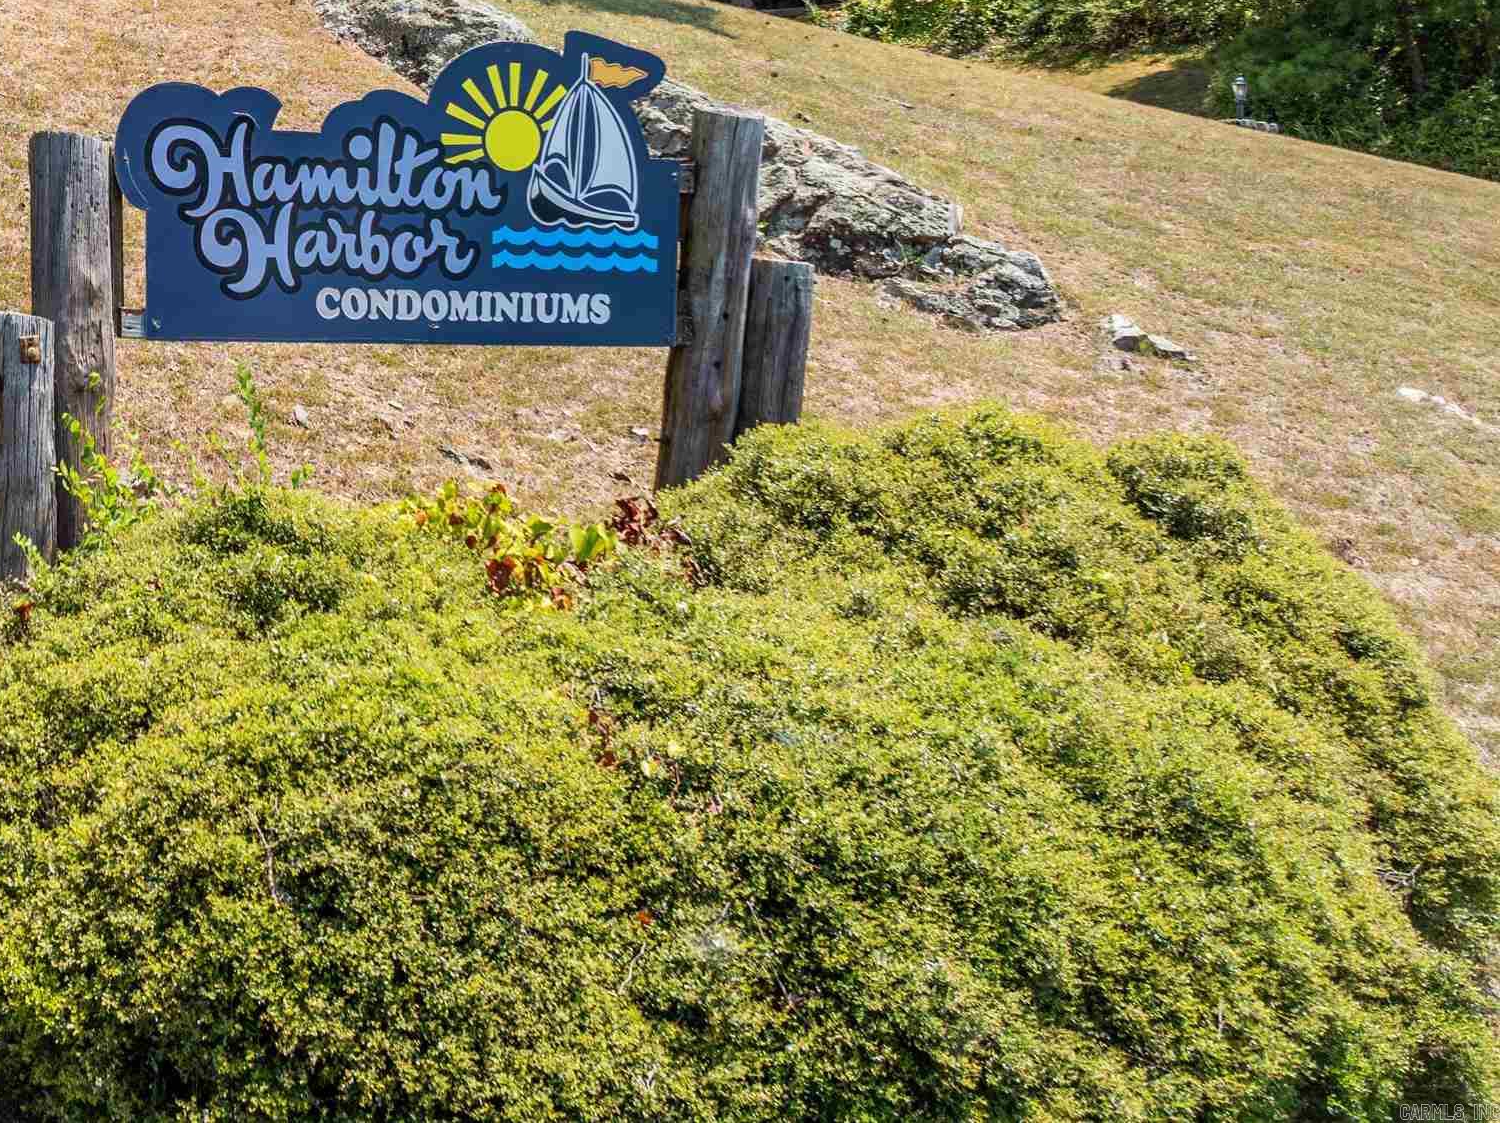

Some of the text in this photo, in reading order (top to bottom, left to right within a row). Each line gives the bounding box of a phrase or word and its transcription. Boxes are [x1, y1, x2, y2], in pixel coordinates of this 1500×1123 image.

[150, 119, 502, 217] Hamilton
[200, 203, 475, 291] Harbor
[315, 286, 612, 324] CONDOMINIUMS
